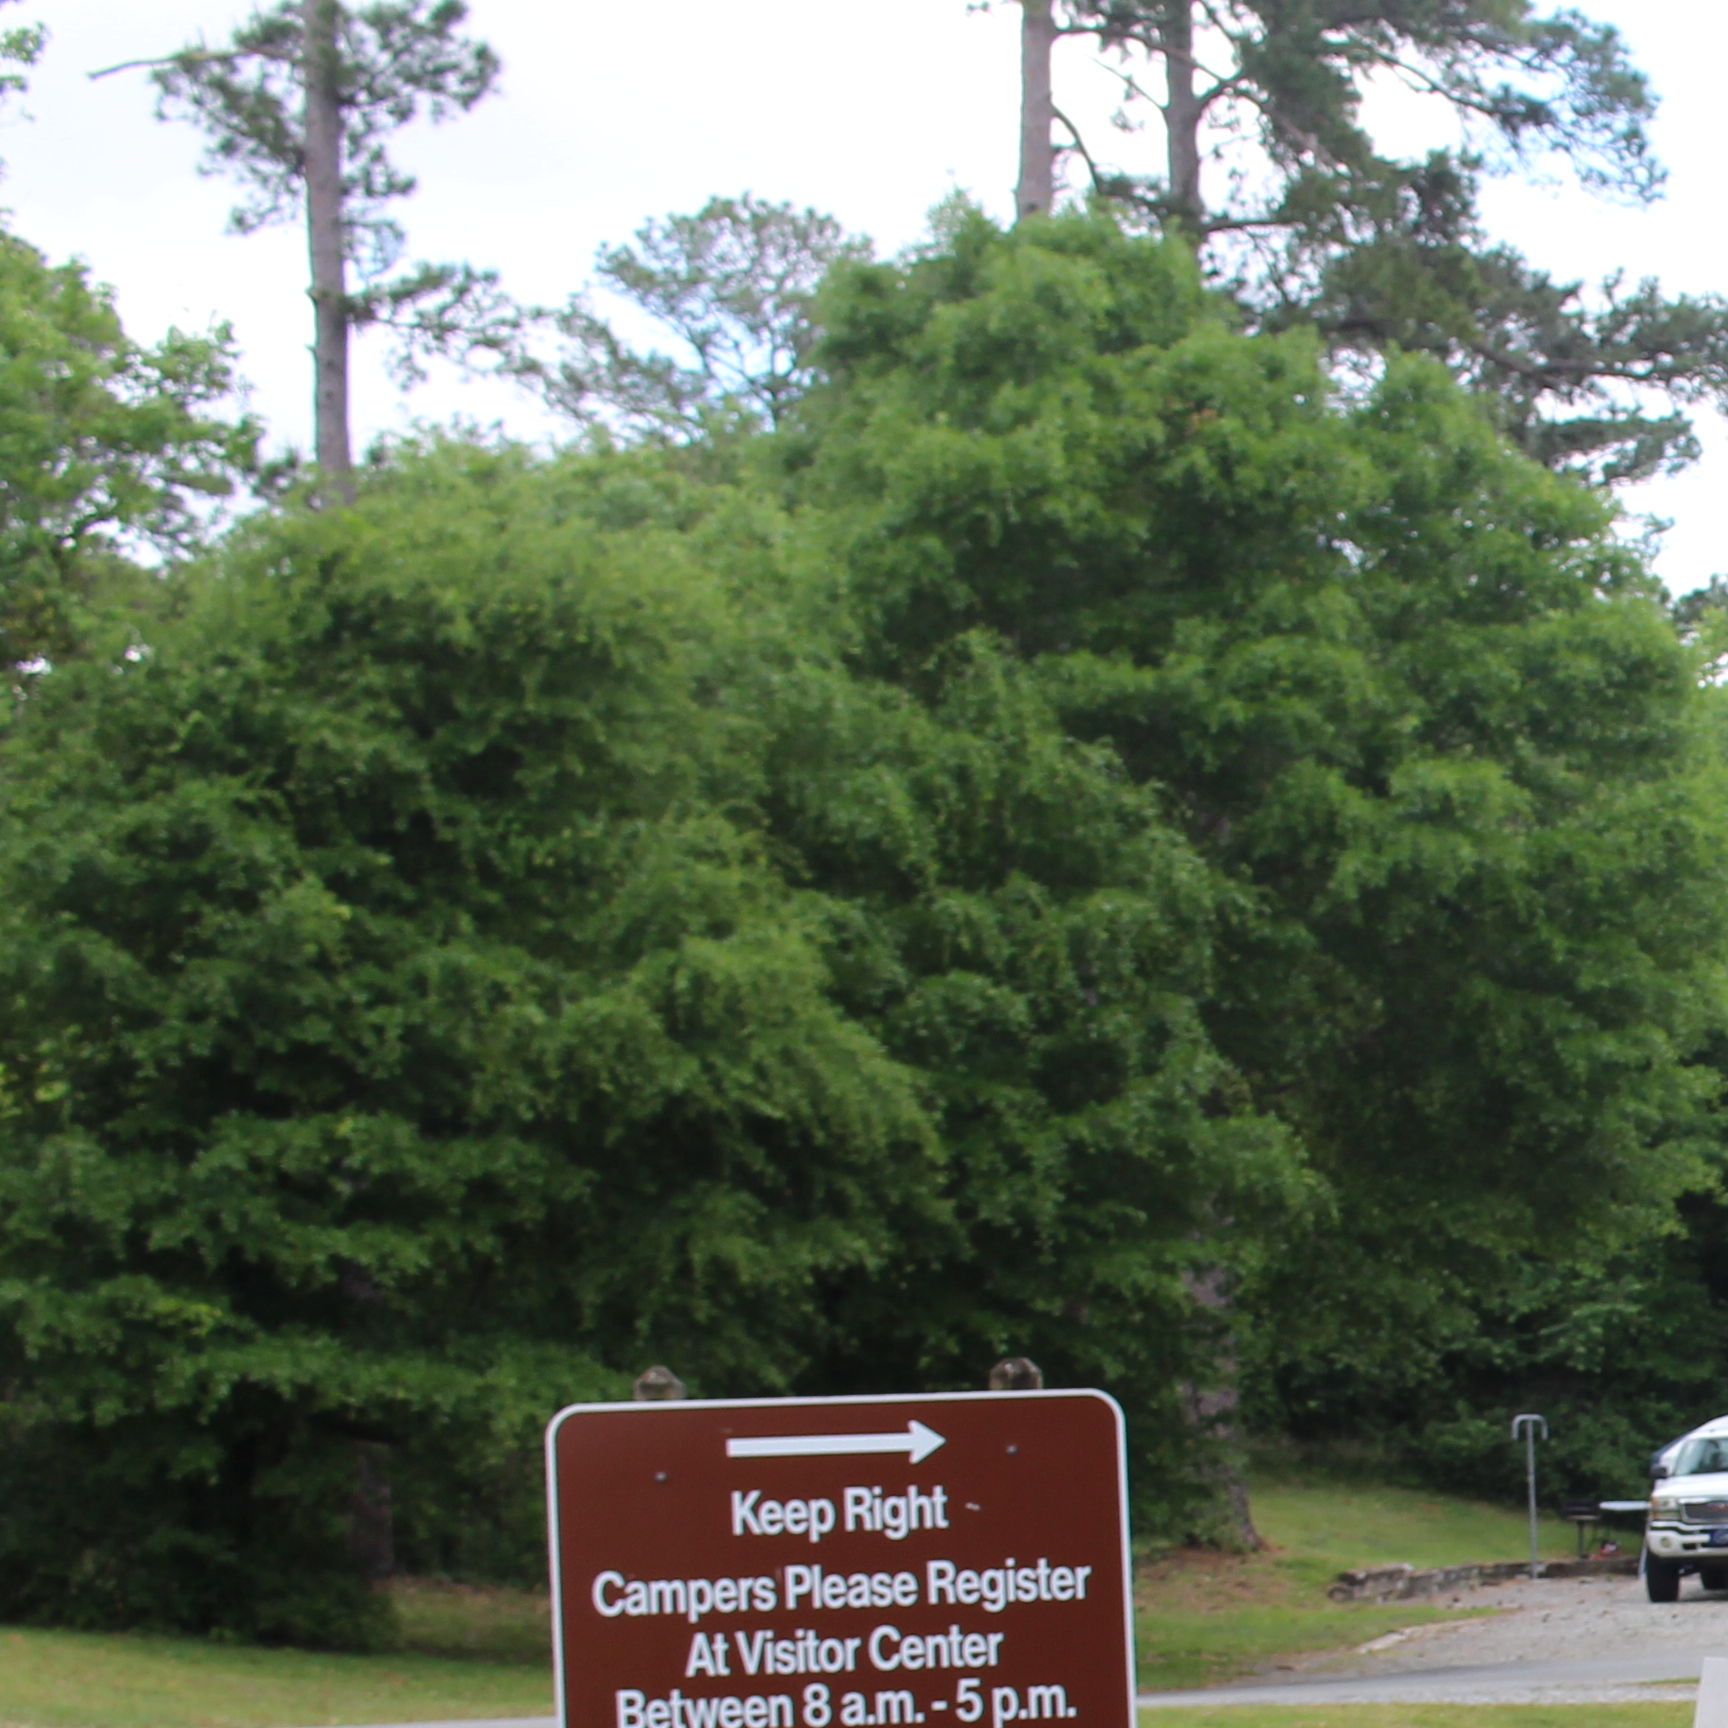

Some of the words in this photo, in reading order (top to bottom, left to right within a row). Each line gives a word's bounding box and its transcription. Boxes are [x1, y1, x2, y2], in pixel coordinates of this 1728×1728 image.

[731, 1489, 835, 1543] Keep
[843, 1485, 949, 1540] Right
[592, 1570, 777, 1624] Campers
[784, 1564, 918, 1610] Please
[926, 1557, 1092, 1613] Register
[685, 1632, 731, 1678] At
[734, 1628, 861, 1675] Visitor
[868, 1624, 1004, 1671] Center
[803, 1682, 831, 1728] 8
[840, 1690, 925, 1727] a.m.
[956, 1677, 983, 1722] 5
